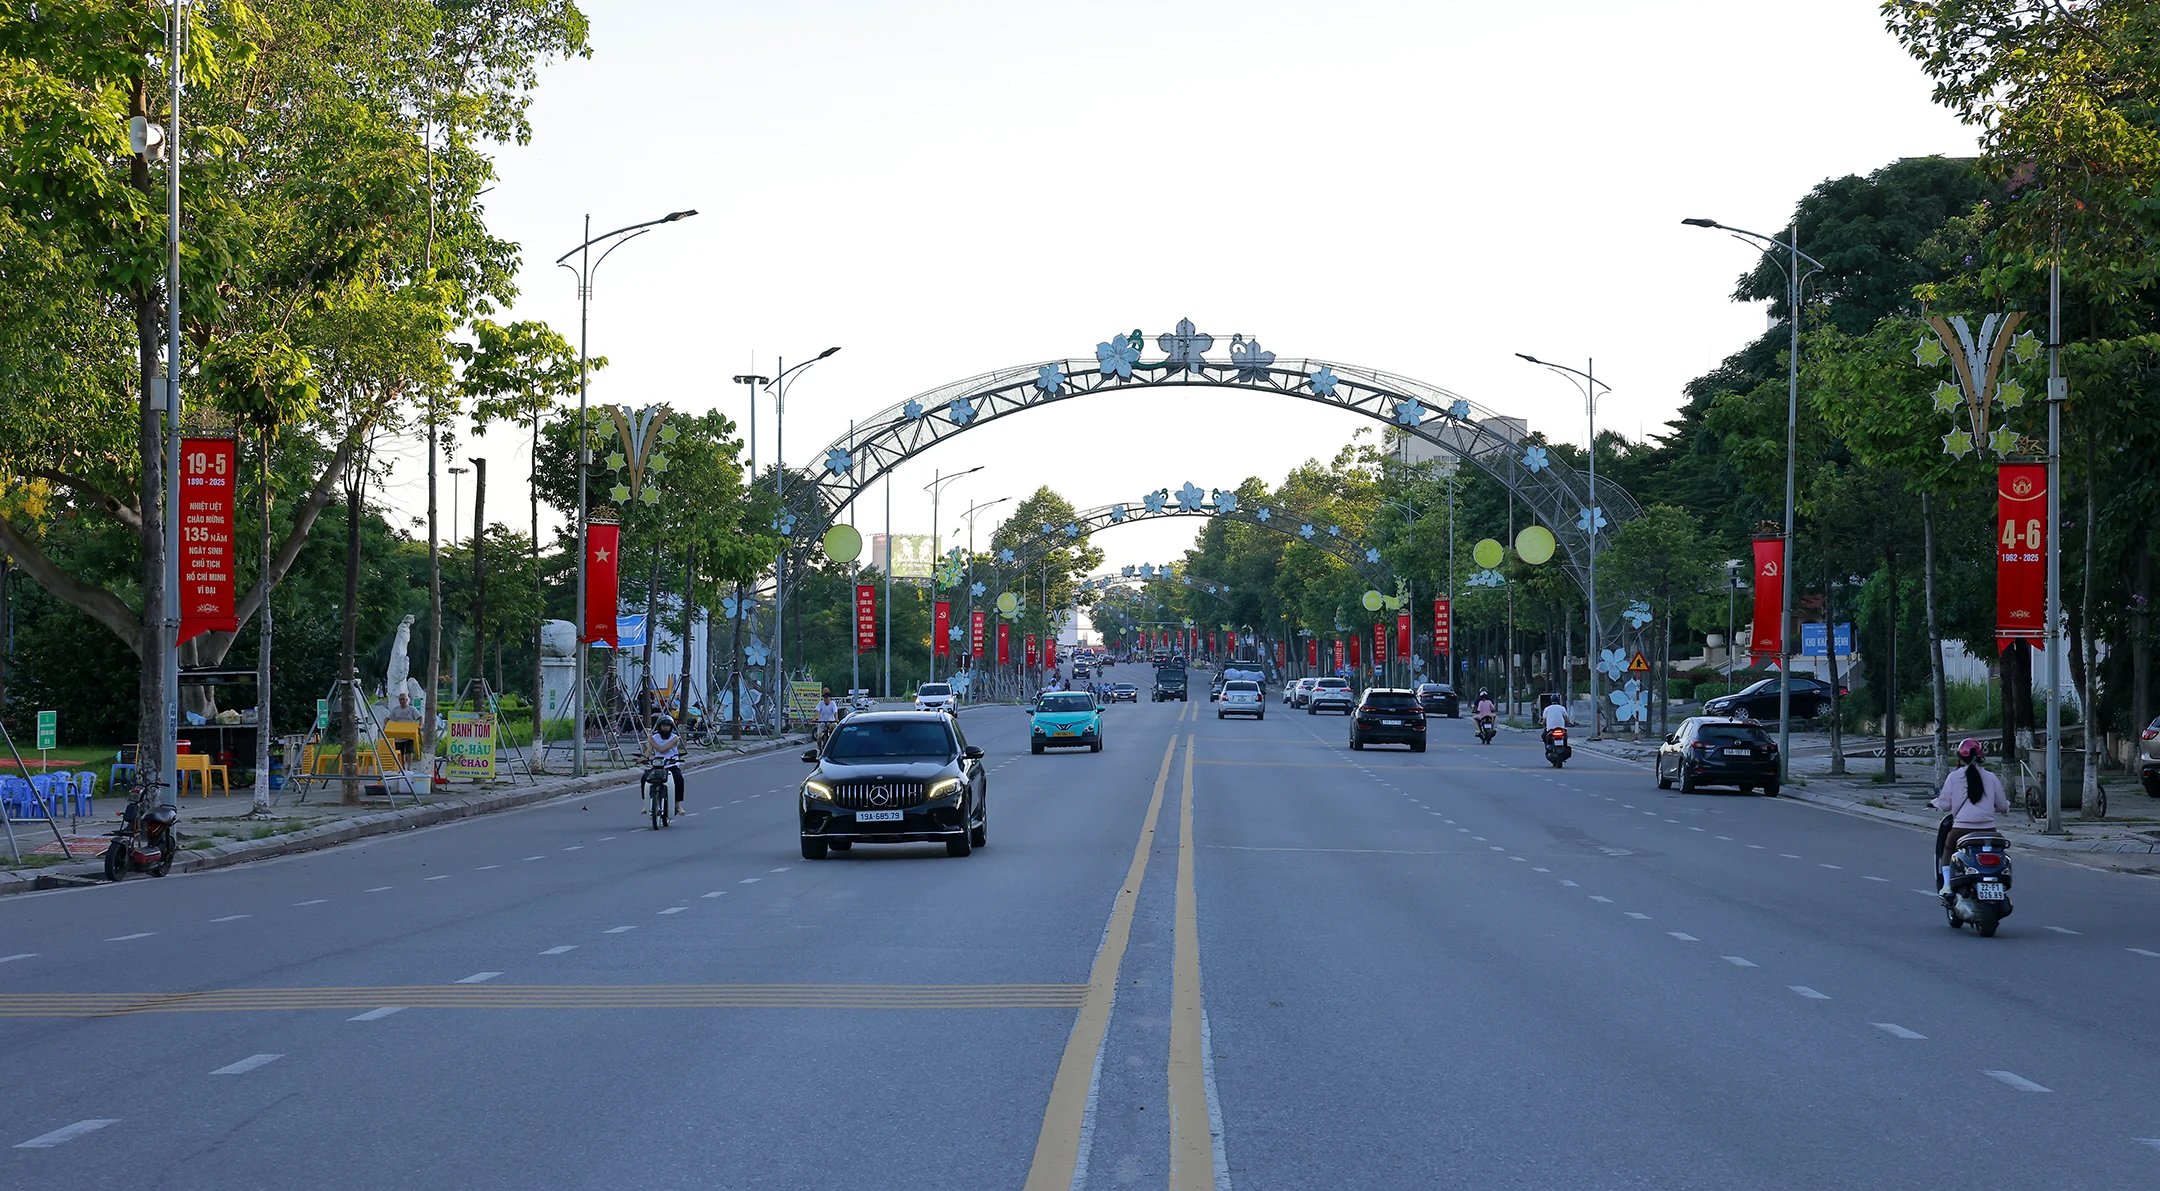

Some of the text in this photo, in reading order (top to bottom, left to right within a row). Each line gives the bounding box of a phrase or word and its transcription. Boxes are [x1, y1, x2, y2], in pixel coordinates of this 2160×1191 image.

[187, 453, 226, 474] 19-5
[190, 501, 222, 512] NHIỆT LIỆT
[187, 514, 224, 523] CHÀO MỪNG
[184, 527, 227, 542] 135 NĂM
[2002, 519, 2040, 549] 4-6
[189, 545, 206, 554] NGÀY
[192, 558, 220, 569] CHỦ TỊCH
[197, 572, 207, 580] CHÍ
[452, 720, 472, 737] BÁNH
[461, 757, 488, 767] CHÁO
